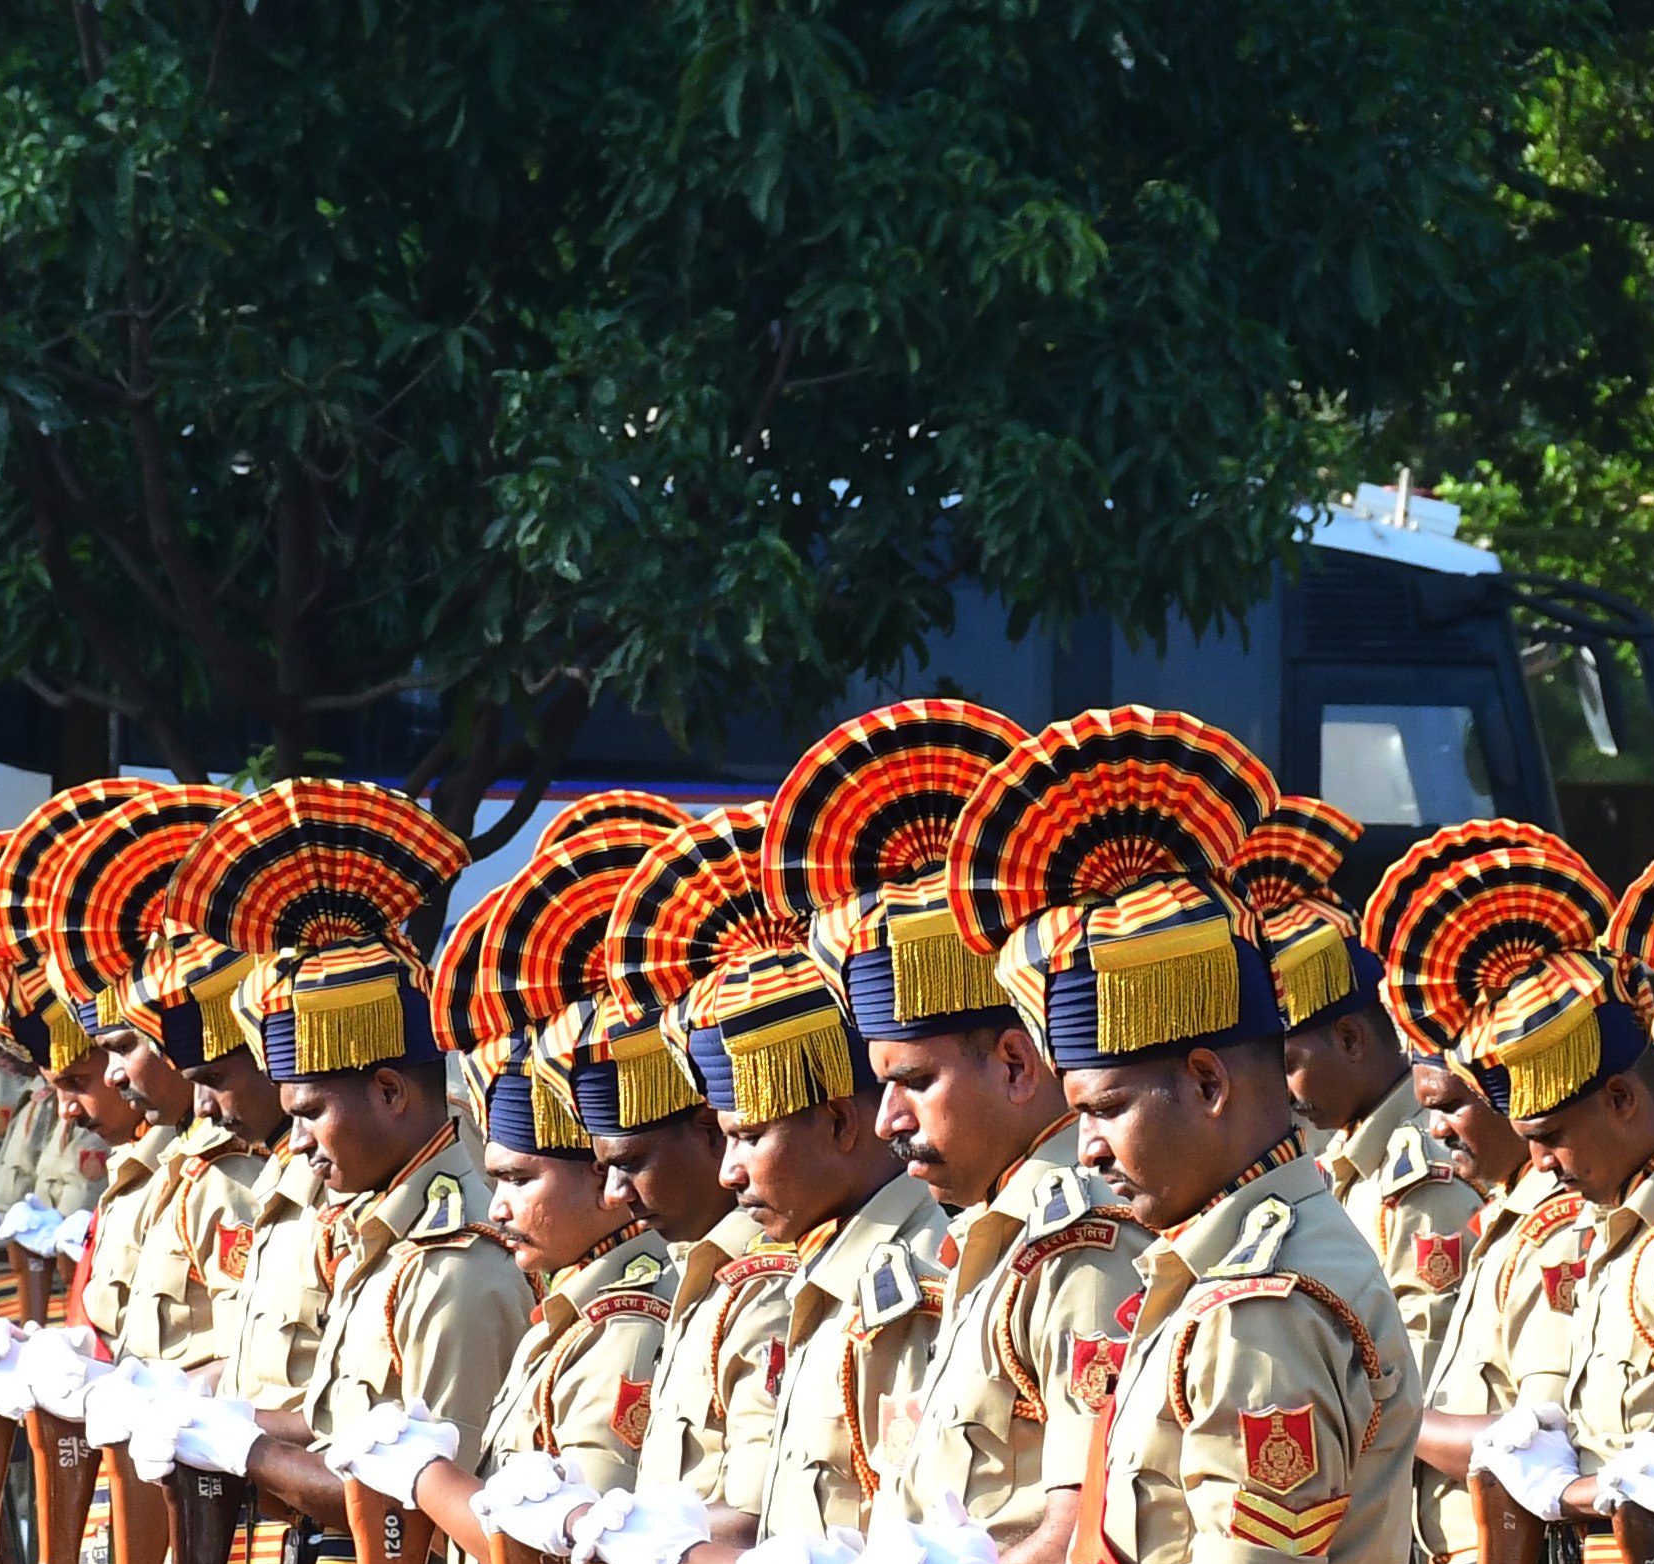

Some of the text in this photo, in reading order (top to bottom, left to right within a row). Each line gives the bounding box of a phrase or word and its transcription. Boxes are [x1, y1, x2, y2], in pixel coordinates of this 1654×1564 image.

[724, 1264, 749, 1283] मध्य
[750, 1256, 779, 1271] प्रदेश
[613, 1297, 639, 1309] प्रदेश
[1503, 1512, 1516, 1531] 27
[384, 1514, 402, 1561] 1260
